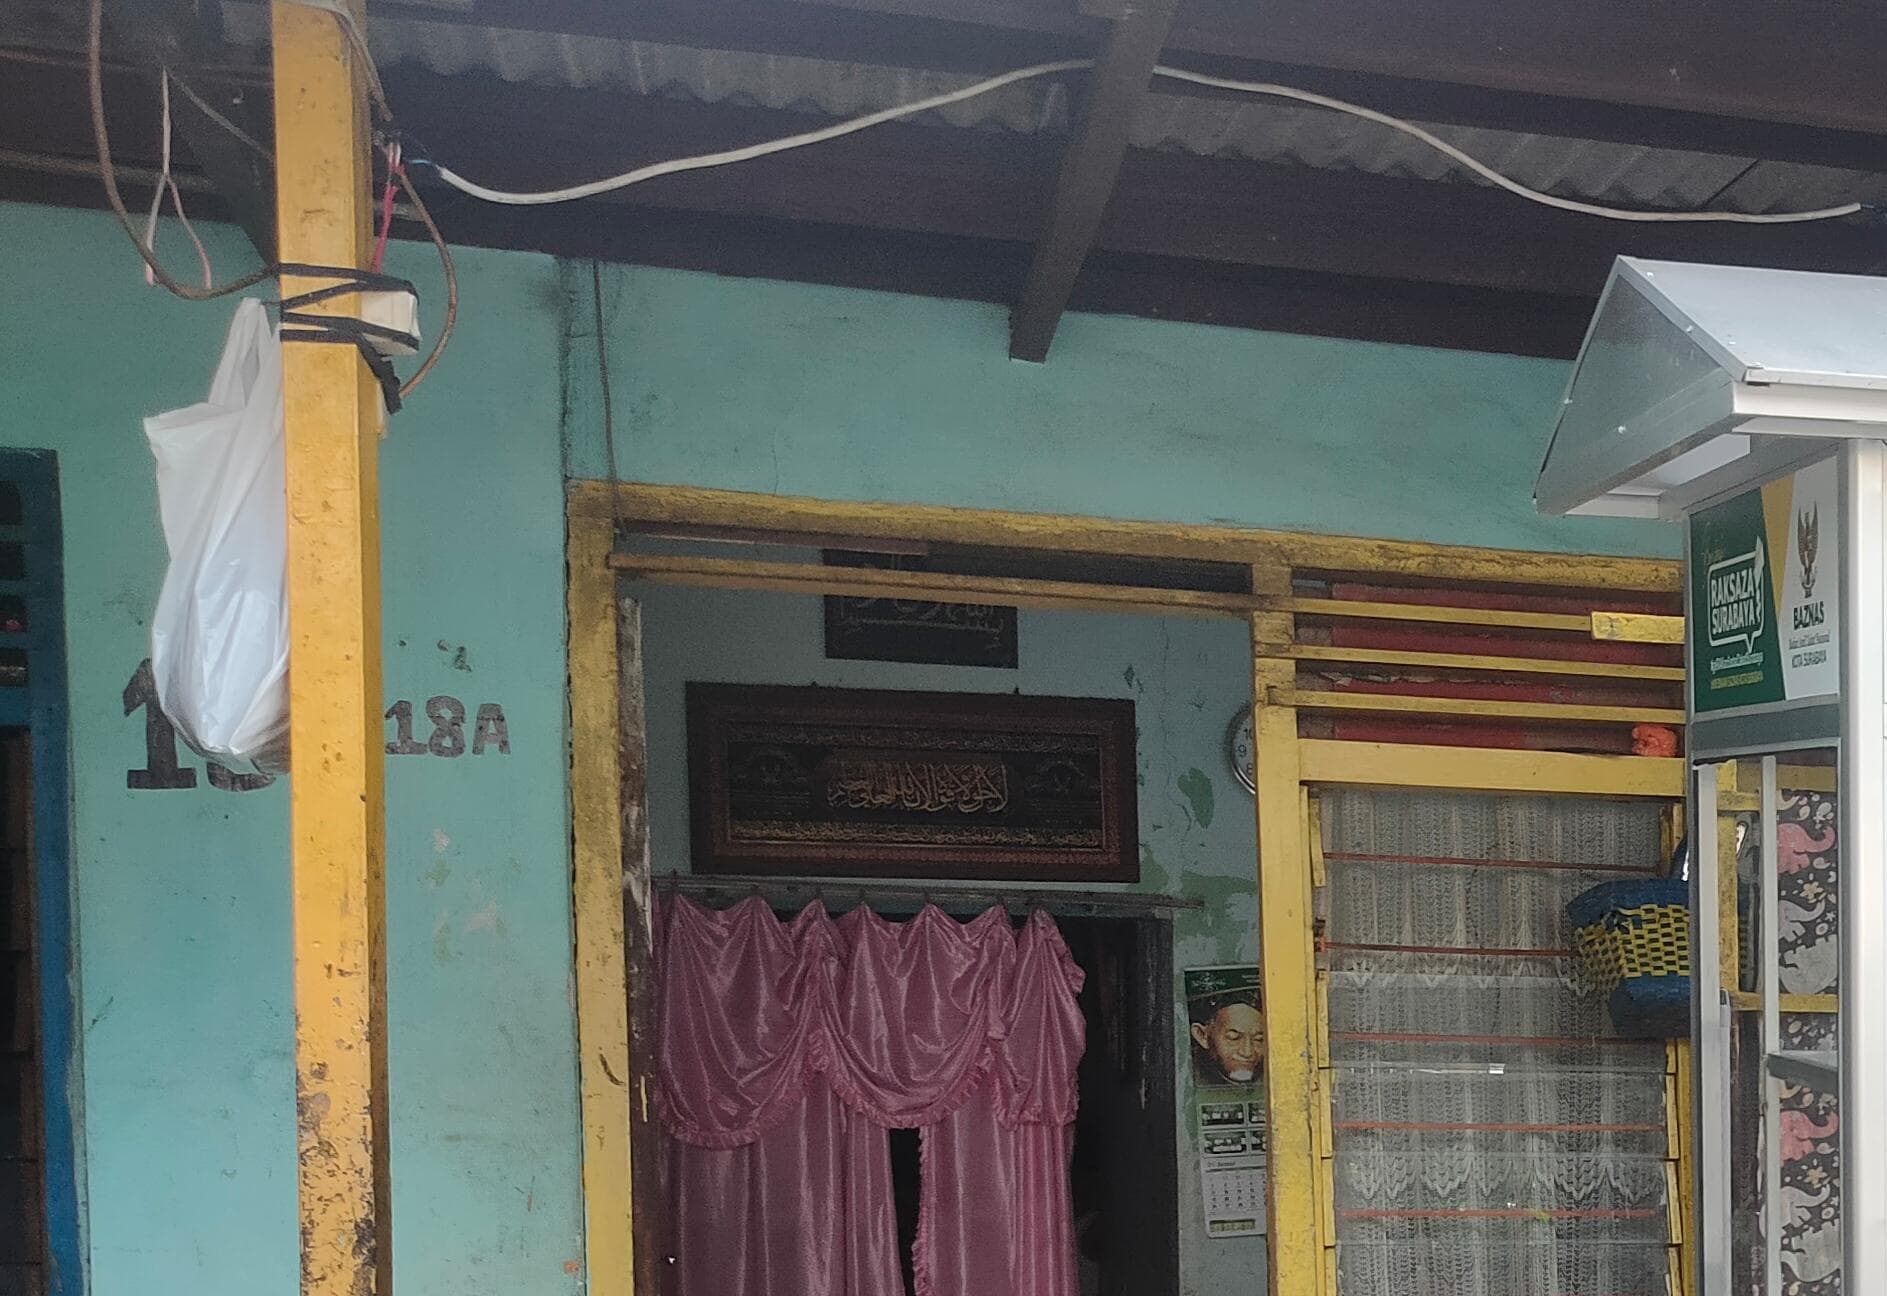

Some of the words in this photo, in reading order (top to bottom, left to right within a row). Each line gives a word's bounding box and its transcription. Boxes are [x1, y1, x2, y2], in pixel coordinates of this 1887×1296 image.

[1711, 568, 1754, 607] RAKSAZA
[1712, 599, 1756, 635] SURABAYA
[1794, 600, 1825, 630] BAZNAS
[384, 695, 511, 759] 18A
